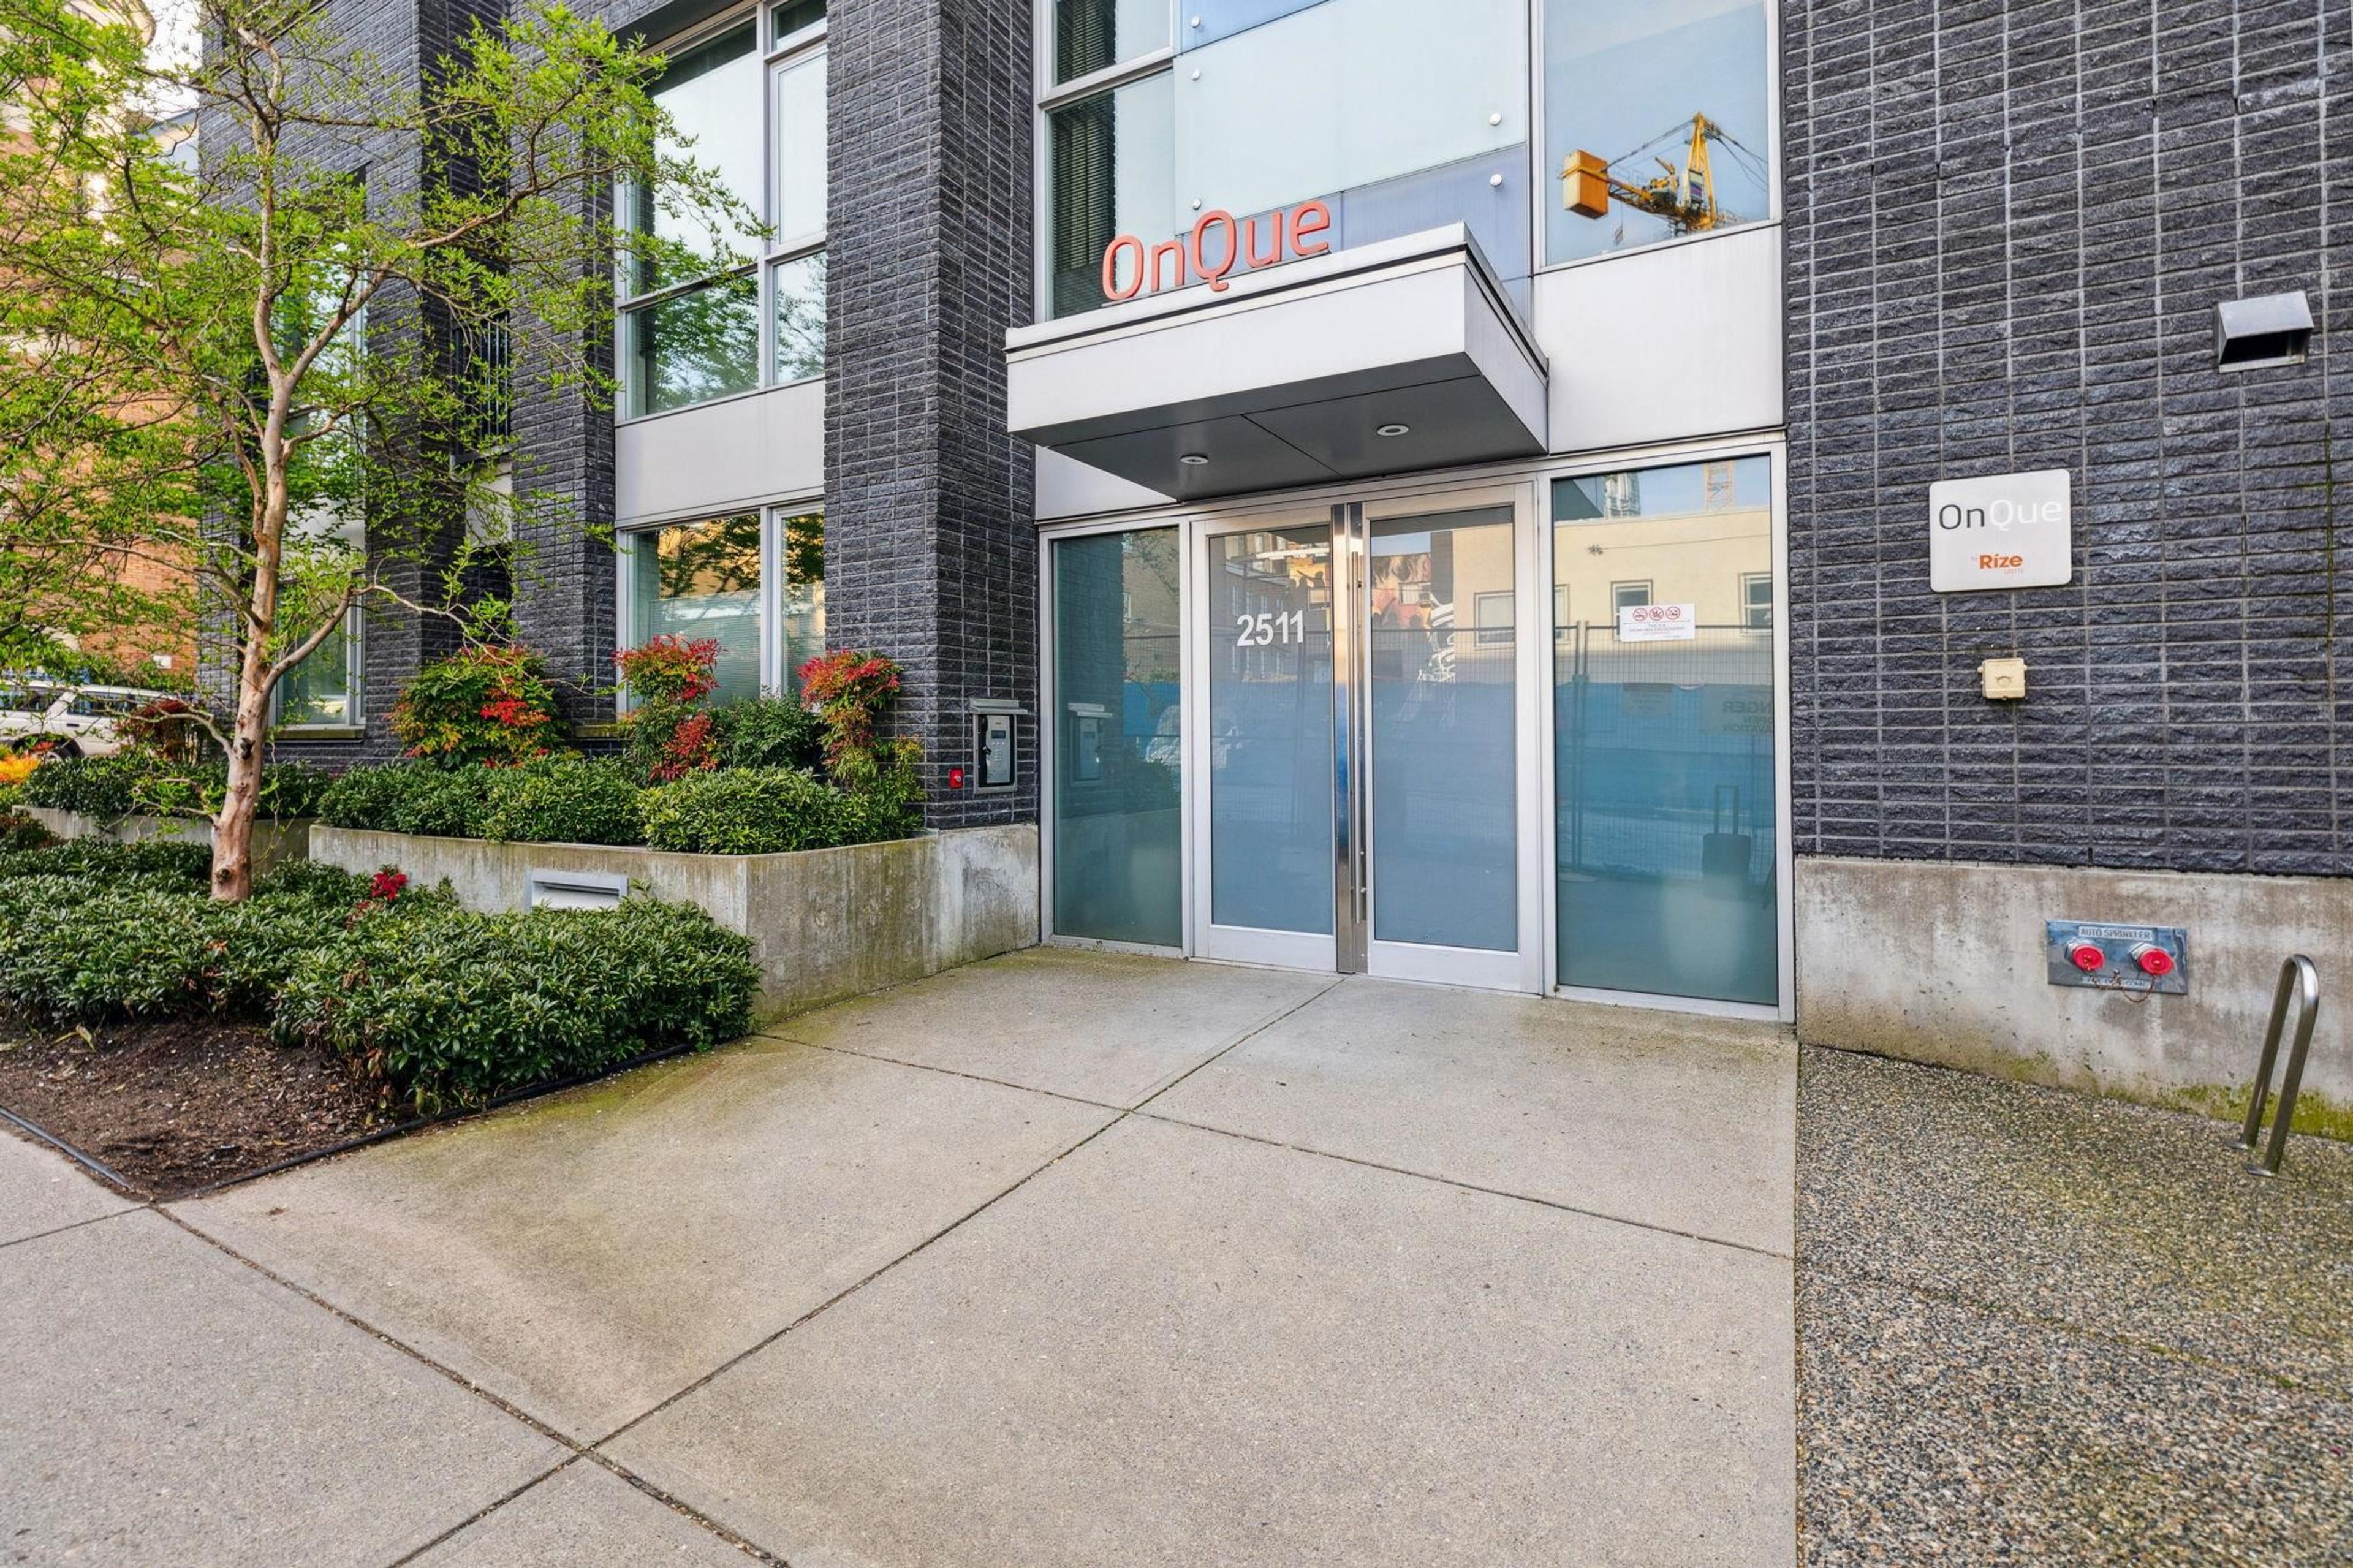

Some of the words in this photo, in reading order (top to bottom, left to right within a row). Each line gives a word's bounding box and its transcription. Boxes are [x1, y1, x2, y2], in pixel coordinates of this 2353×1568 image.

[1102, 199, 1330, 301] OnQue
[1939, 499, 2063, 531] OnQue
[1979, 553, 2023, 569] Rize
[1236, 610, 1305, 647] 2511
[2080, 928, 2102, 937] AUTO
[2104, 929, 2151, 939] SPRINKLER
